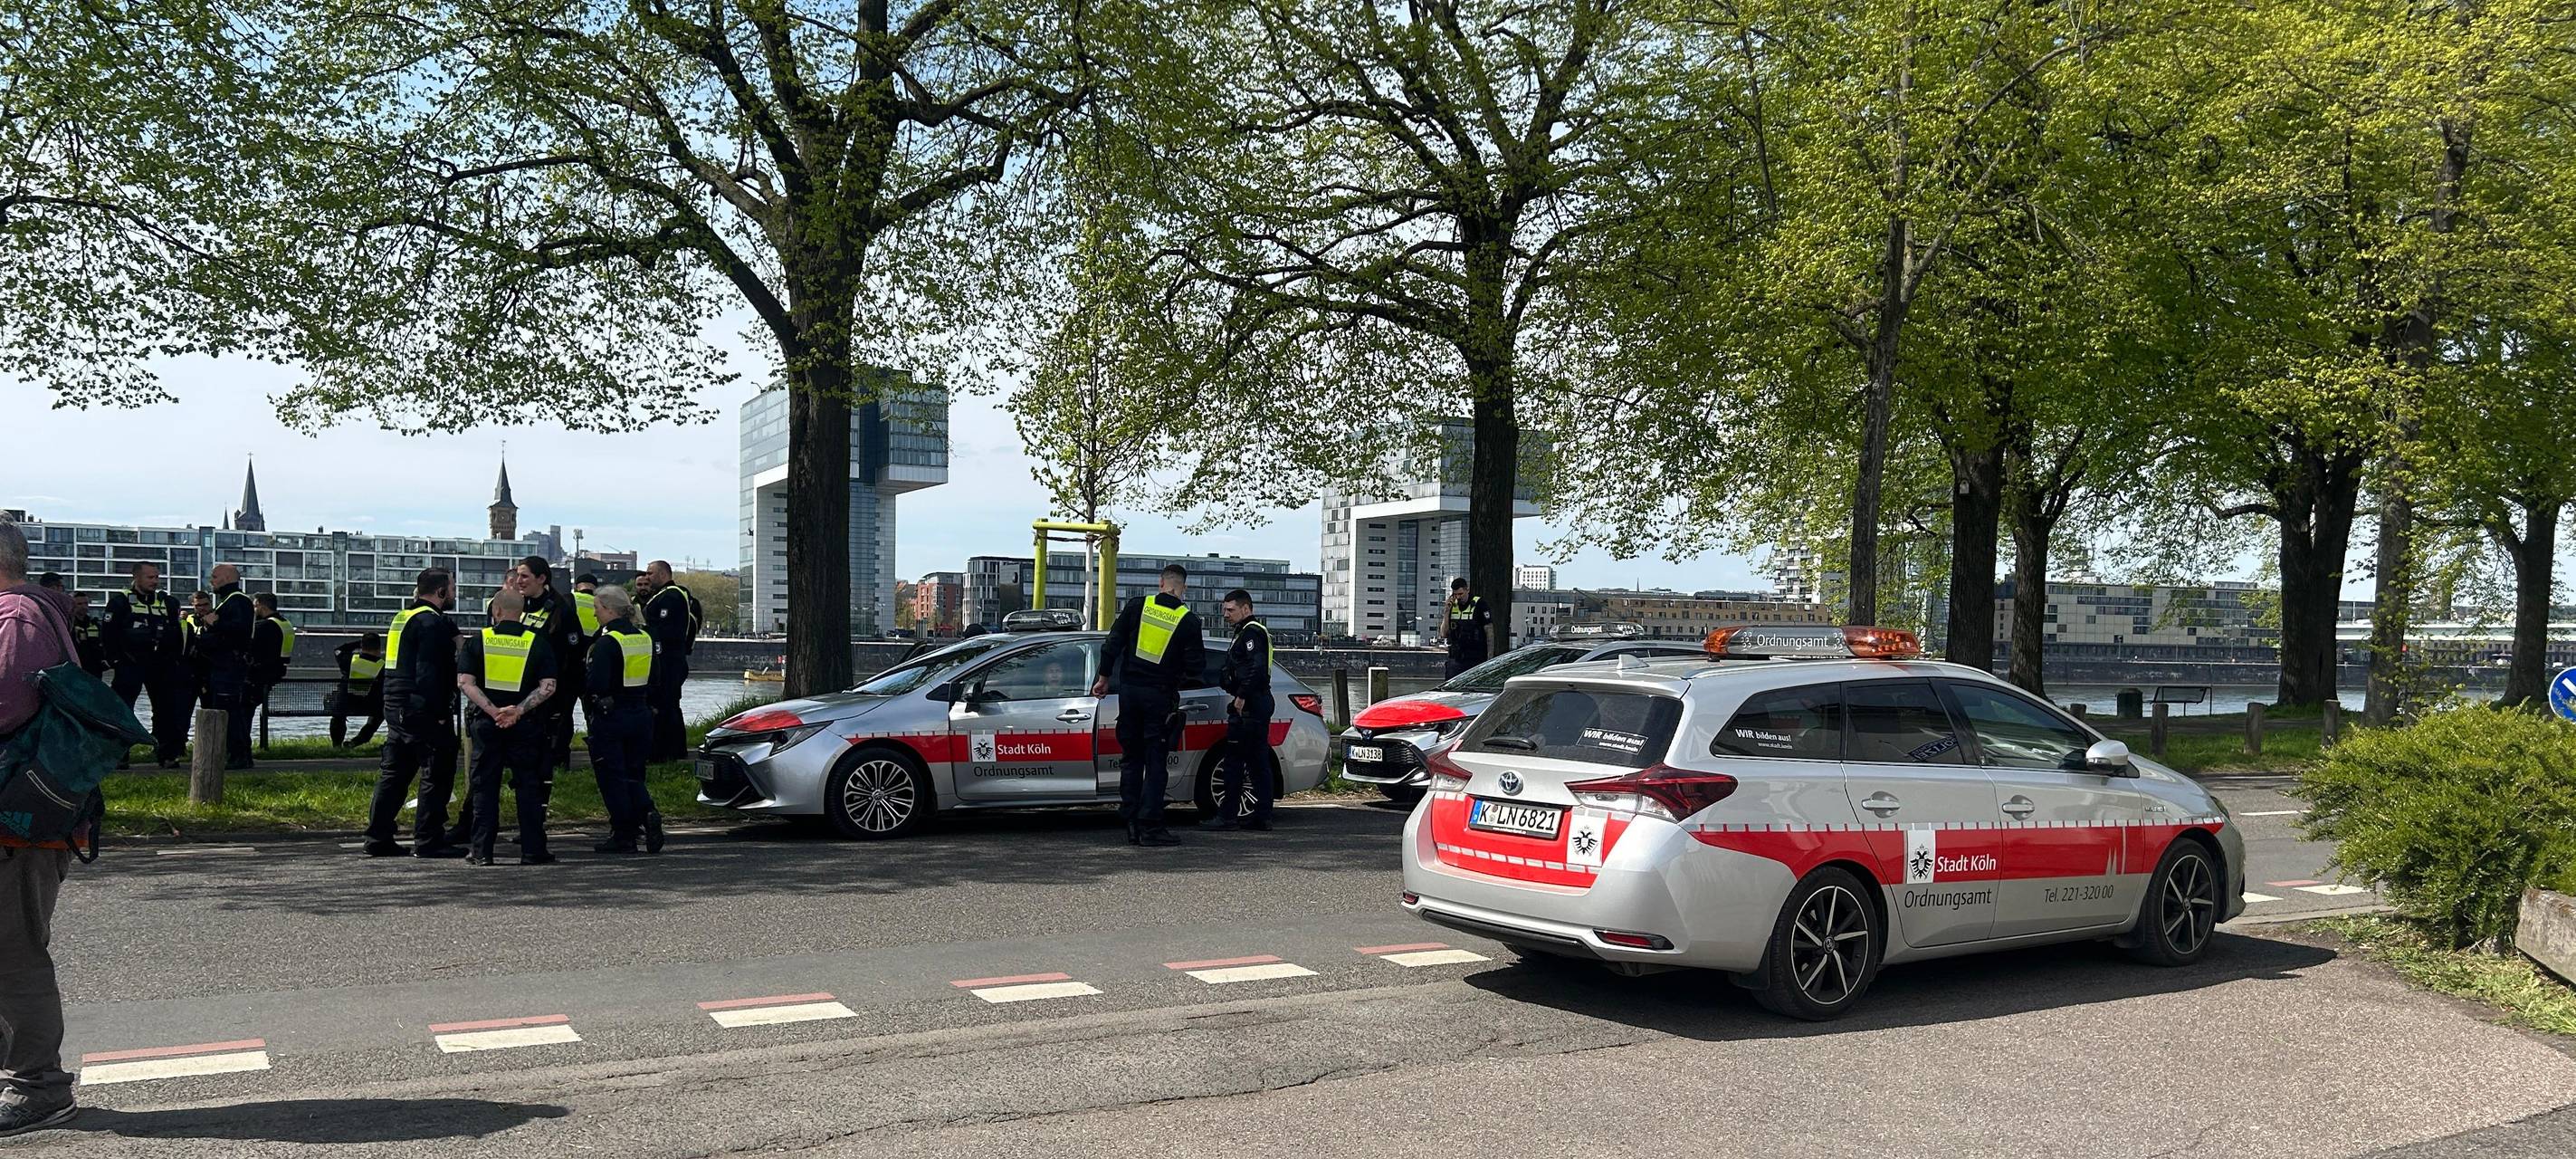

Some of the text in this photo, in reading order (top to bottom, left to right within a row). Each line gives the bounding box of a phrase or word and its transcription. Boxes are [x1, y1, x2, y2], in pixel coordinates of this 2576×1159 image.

[485, 637, 530, 647] ORDNUNGSAMT
[1757, 634, 1828, 650] Ordnungsamt
[1584, 730, 1602, 739] WIR
[1603, 732, 1627, 742] bilden
[1735, 729, 1754, 739] WIR
[1756, 731, 1778, 741] bilden
[997, 742, 1052, 755] Stadt Köln
[973, 765, 1054, 779] Ordnungsamt
[1480, 804, 1491, 823] K
[1937, 853, 1997, 873] Stadt Köln
[1904, 888, 1992, 911] Ordnungsamt
[2045, 887, 2059, 903] Tel.
